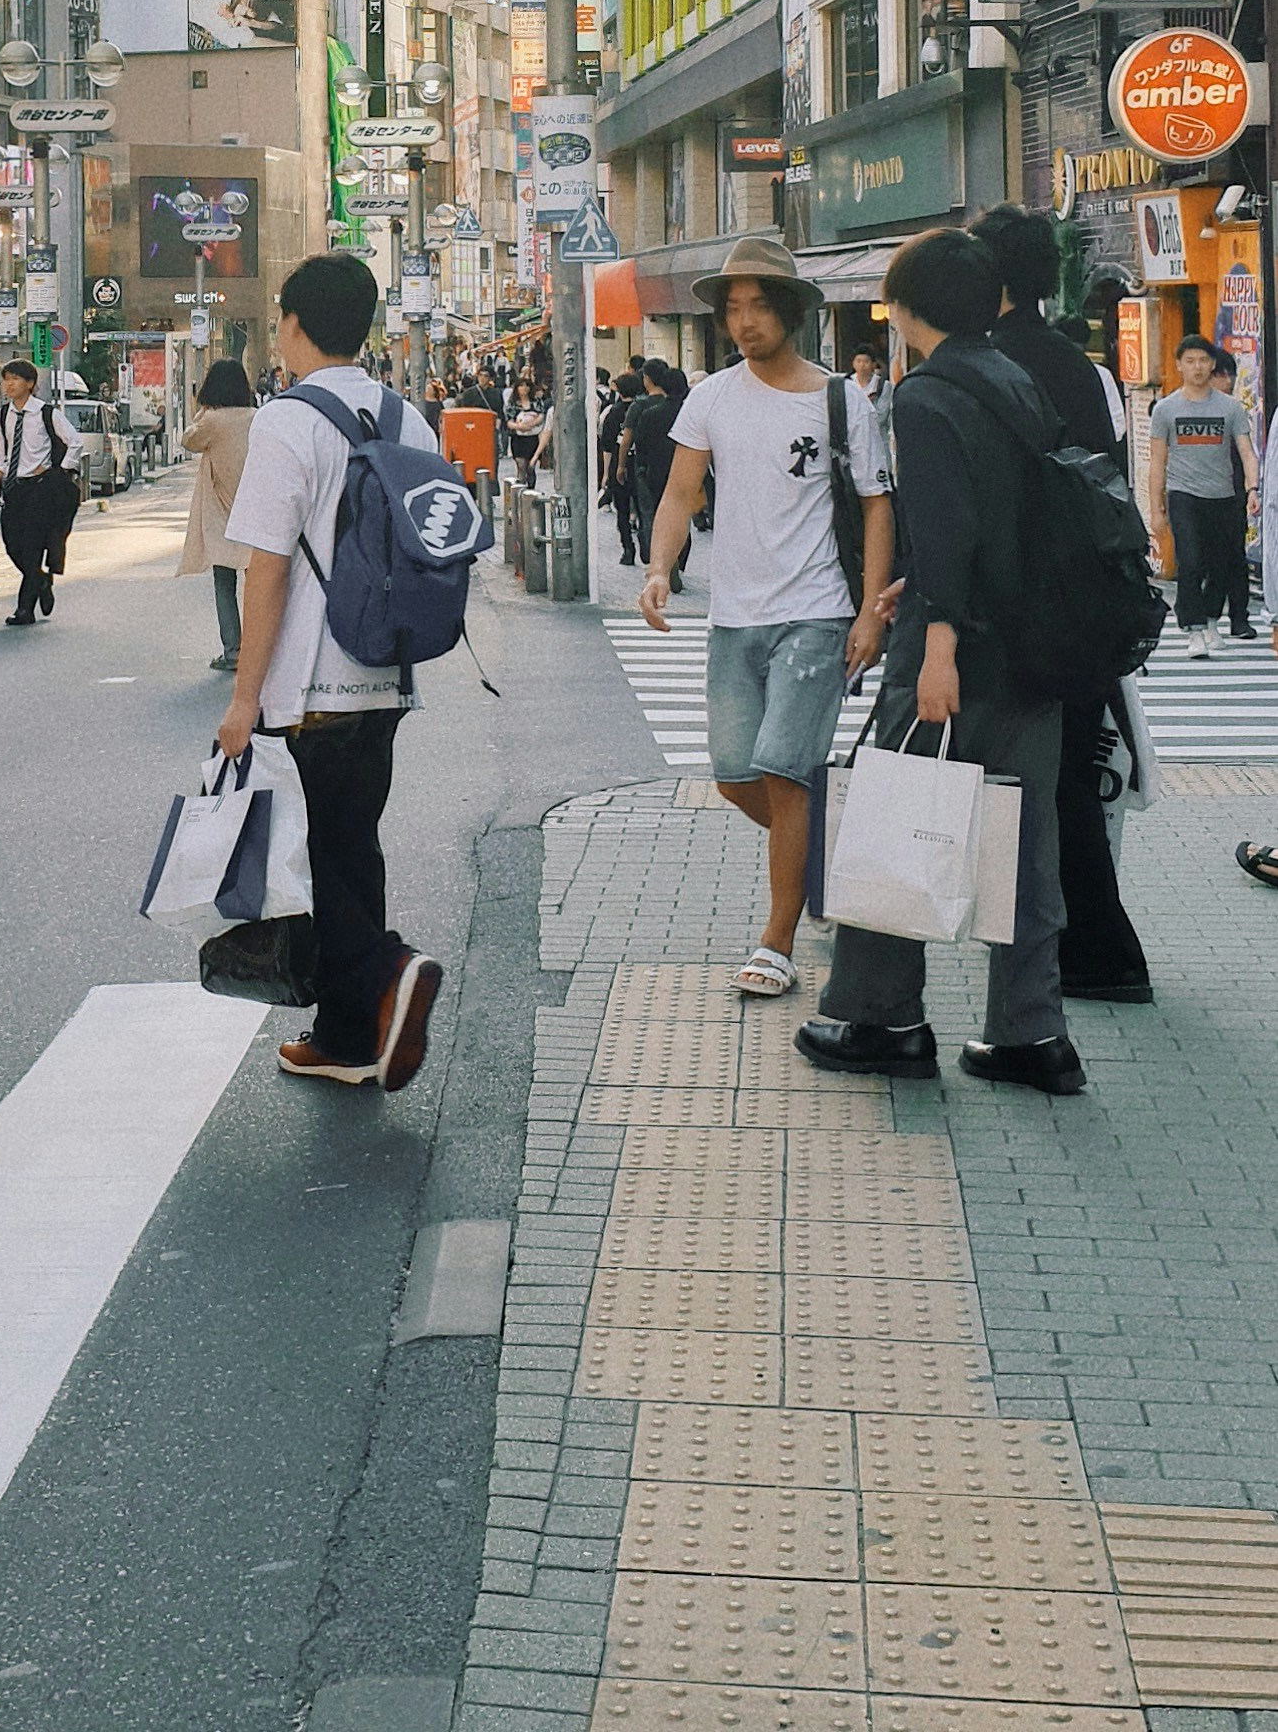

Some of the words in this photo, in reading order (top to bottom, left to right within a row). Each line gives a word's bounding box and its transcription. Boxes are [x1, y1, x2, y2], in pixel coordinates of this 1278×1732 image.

[1169, 37, 1194, 54] 6F
[1126, 76, 1244, 109] amber
[15, 108, 110, 122] 渋谷センター街
[351, 125, 437, 137] 渋谷センター街
[863, 156, 904, 190] PRONTO
[1075, 147, 1154, 194] PRONTO
[174, 292, 219, 304] swch
[1222, 276, 1257, 304] HAPPY
[1232, 304, 1260, 334] HOUR
[372, 680, 402, 692] ALON
